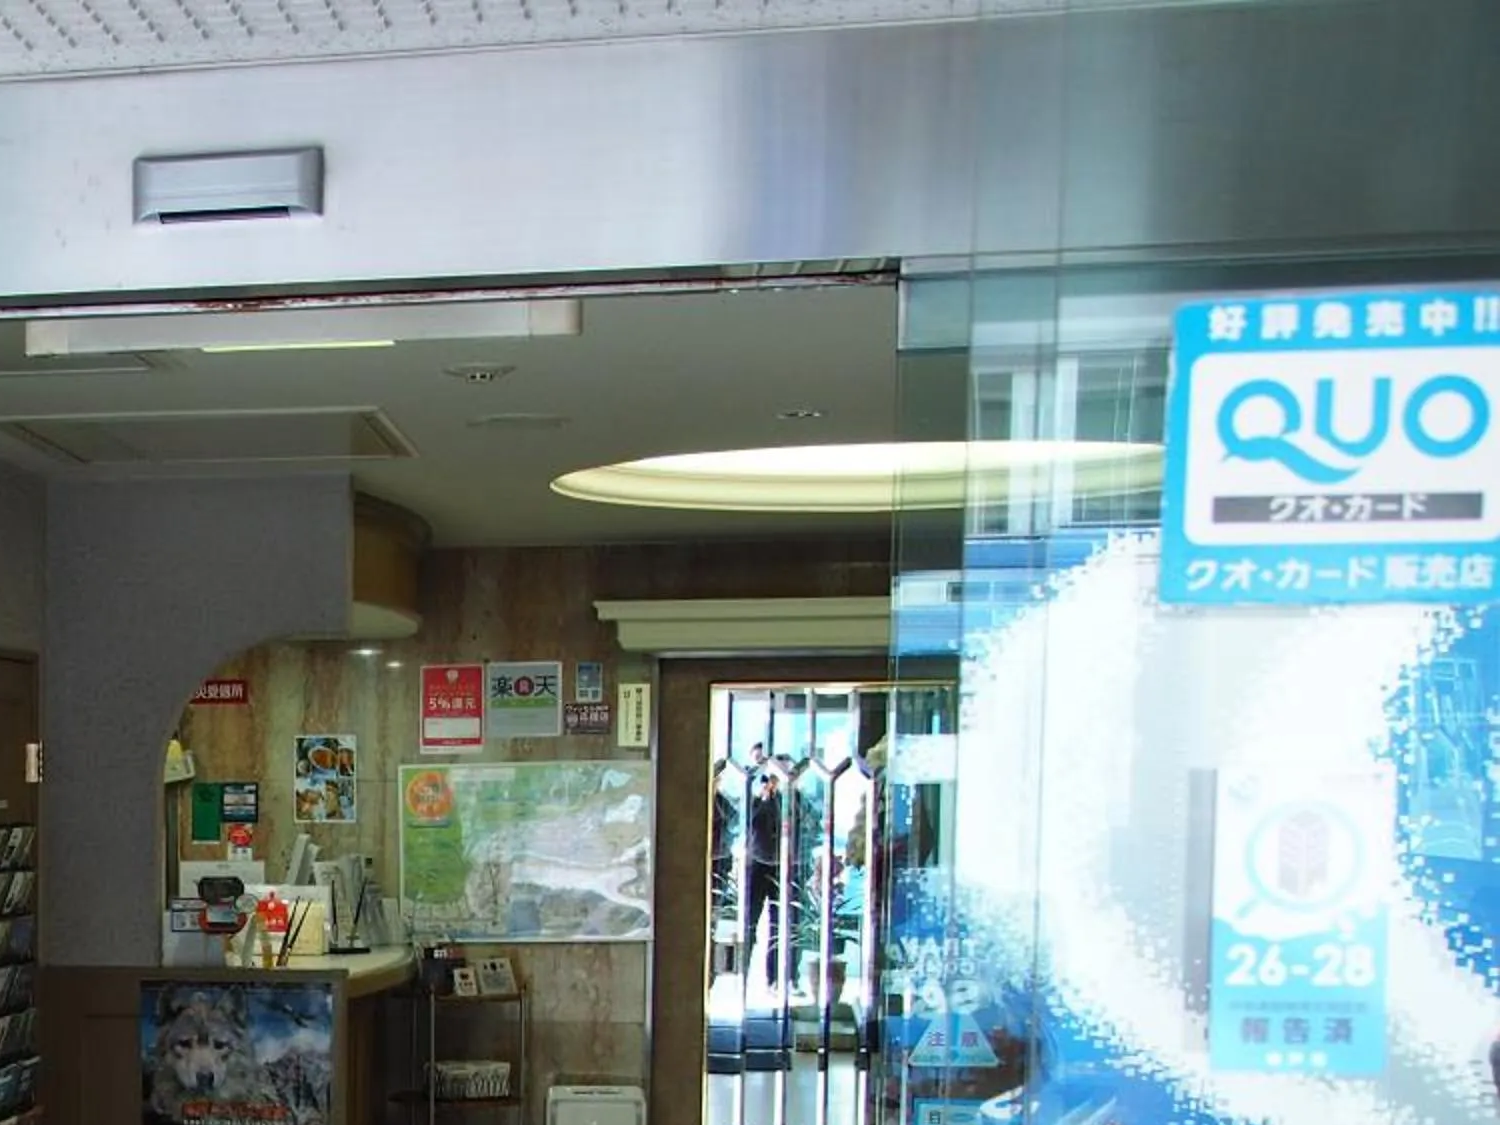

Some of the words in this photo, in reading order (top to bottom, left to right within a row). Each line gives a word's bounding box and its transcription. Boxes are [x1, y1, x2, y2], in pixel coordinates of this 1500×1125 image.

[1217, 374, 1490, 484] QUO
[1269, 495, 1426, 521] クオ・カード
[1224, 944, 1376, 987] 26-28
